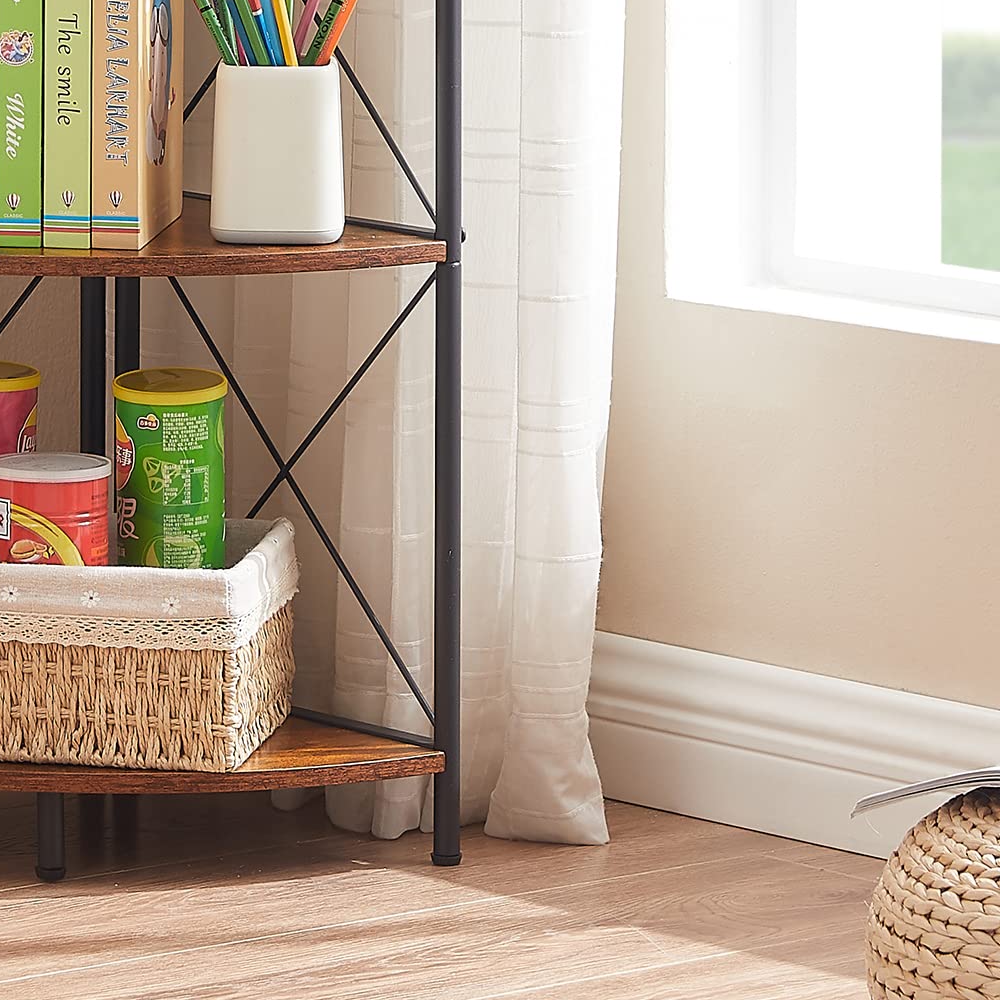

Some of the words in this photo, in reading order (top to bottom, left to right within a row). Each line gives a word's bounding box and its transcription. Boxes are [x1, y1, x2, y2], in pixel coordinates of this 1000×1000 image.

[57, 13, 81, 56] The
[313, 12, 336, 50] NYONI
[57, 66, 81, 125] smile
[5, 93, 25, 160] White
